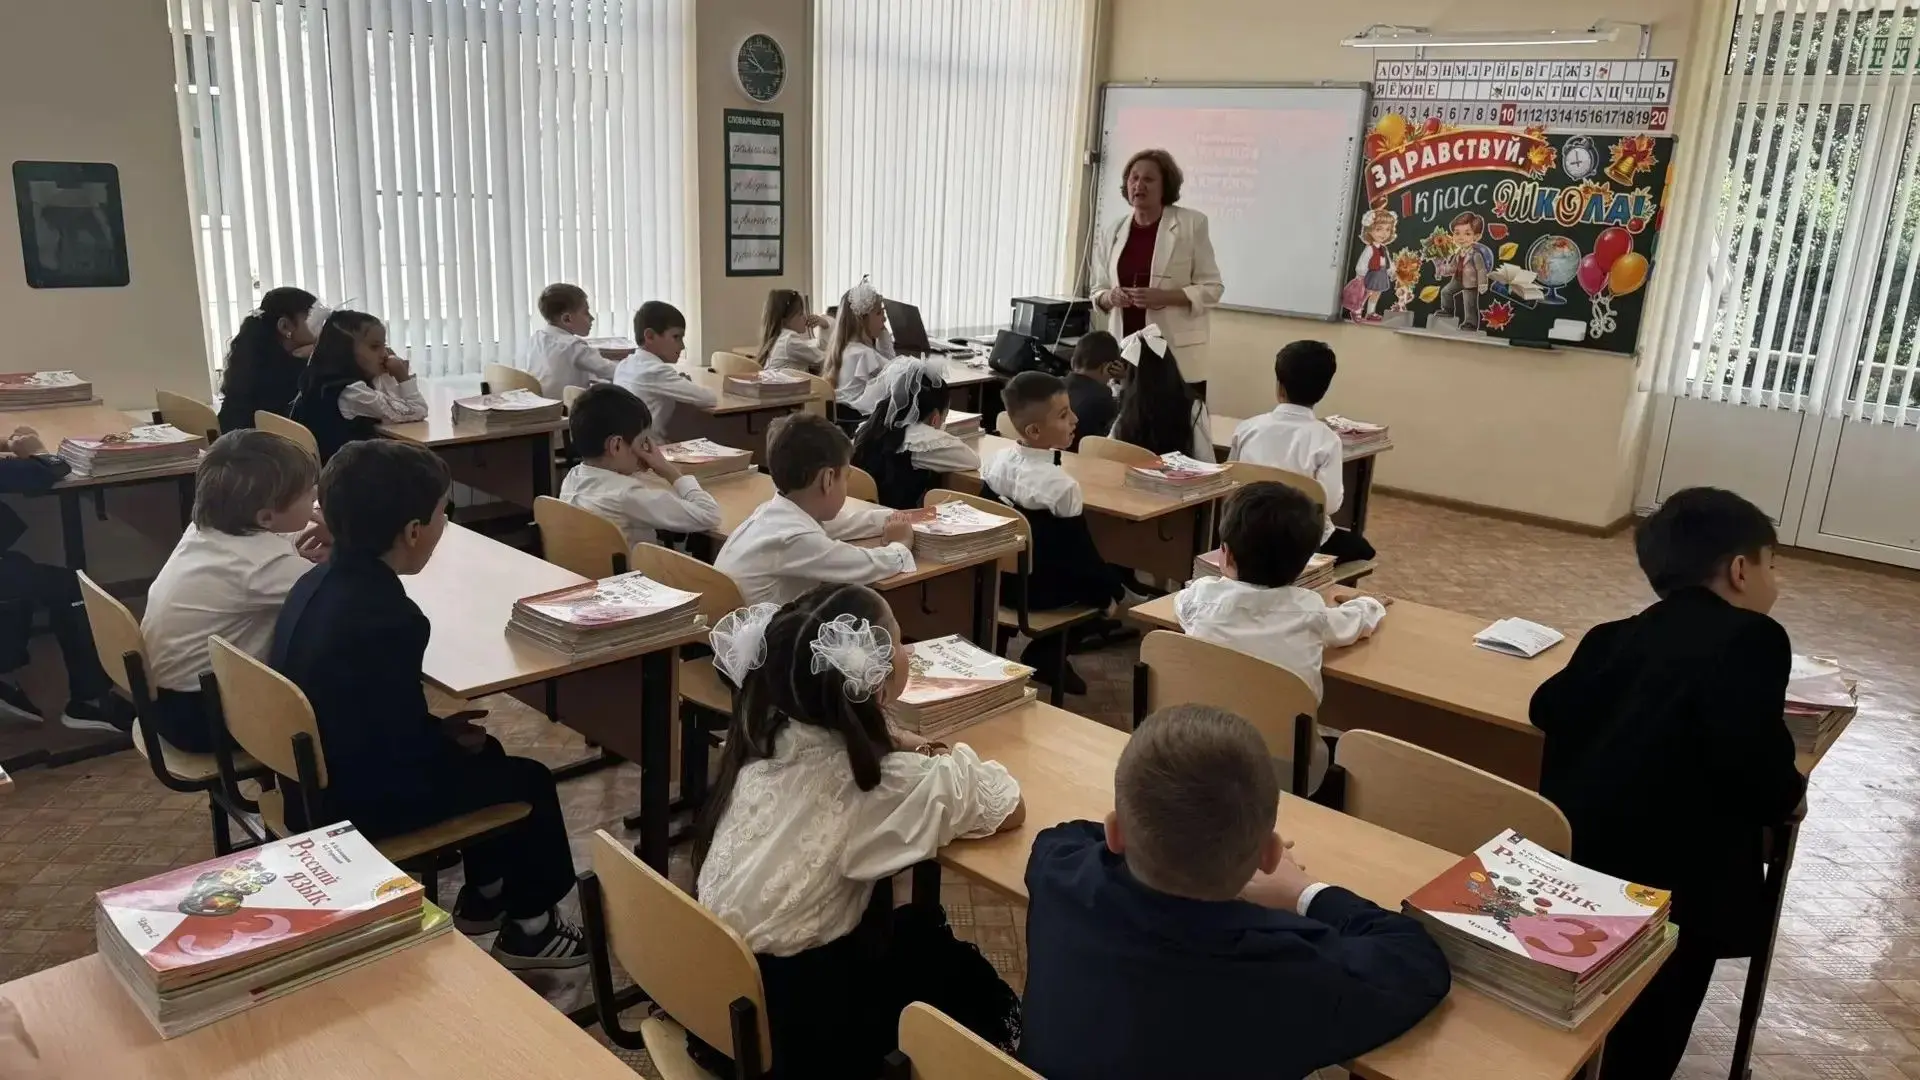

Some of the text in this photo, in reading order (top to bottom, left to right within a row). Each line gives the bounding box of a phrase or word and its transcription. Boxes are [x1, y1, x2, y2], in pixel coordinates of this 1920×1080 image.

[1379, 62, 1670, 78] А О У Ы Э Н М Л Р Й Б В Г Д Ж З Ъ
[1376, 84, 1385, 96] Я
[1400, 84, 1413, 95] Ю
[1428, 84, 1436, 95] Е
[1507, 85, 1517, 97] П
[1520, 85, 1531, 97] Ф
[1536, 86, 1546, 97] К
[1551, 85, 1560, 97] Т
[1562, 86, 1576, 98] Ш
[1579, 85, 1589, 98] С
[1593, 86, 1604, 98] Х
[1609, 86, 1620, 100] Ц
[1625, 86, 1635, 98] Ч
[1656, 87, 1665, 99] Ь
[1372, 105, 1379, 118] 0
[1410, 106, 1417, 119] 3
[1422, 106, 1430, 119] 4
[1436, 107, 1443, 119] 5
[1449, 107, 1457, 120] 6
[1463, 107, 1470, 120] 7
[1476, 107, 1484, 121] 8
[1490, 108, 1498, 121] 9
[1501, 108, 1515, 122] 10
[1517, 108, 1528, 122] 11
[1530, 108, 1543, 122] 12
[1545, 108, 1558, 122] 13
[1559, 109, 1572, 123] 14
[1574, 109, 1588, 123] 15
[1589, 110, 1603, 124] 16
[1604, 110, 1619, 124] 17
[1620, 110, 1634, 125] 18
[1635, 110, 1650, 125] 19
[1651, 111, 1667, 126] 20
[1371, 137, 1525, 189] ЗДРАВСТВУЙ,
[1493, 179, 1648, 234] ШКОЛА!
[1523, 917, 1609, 957] 3
